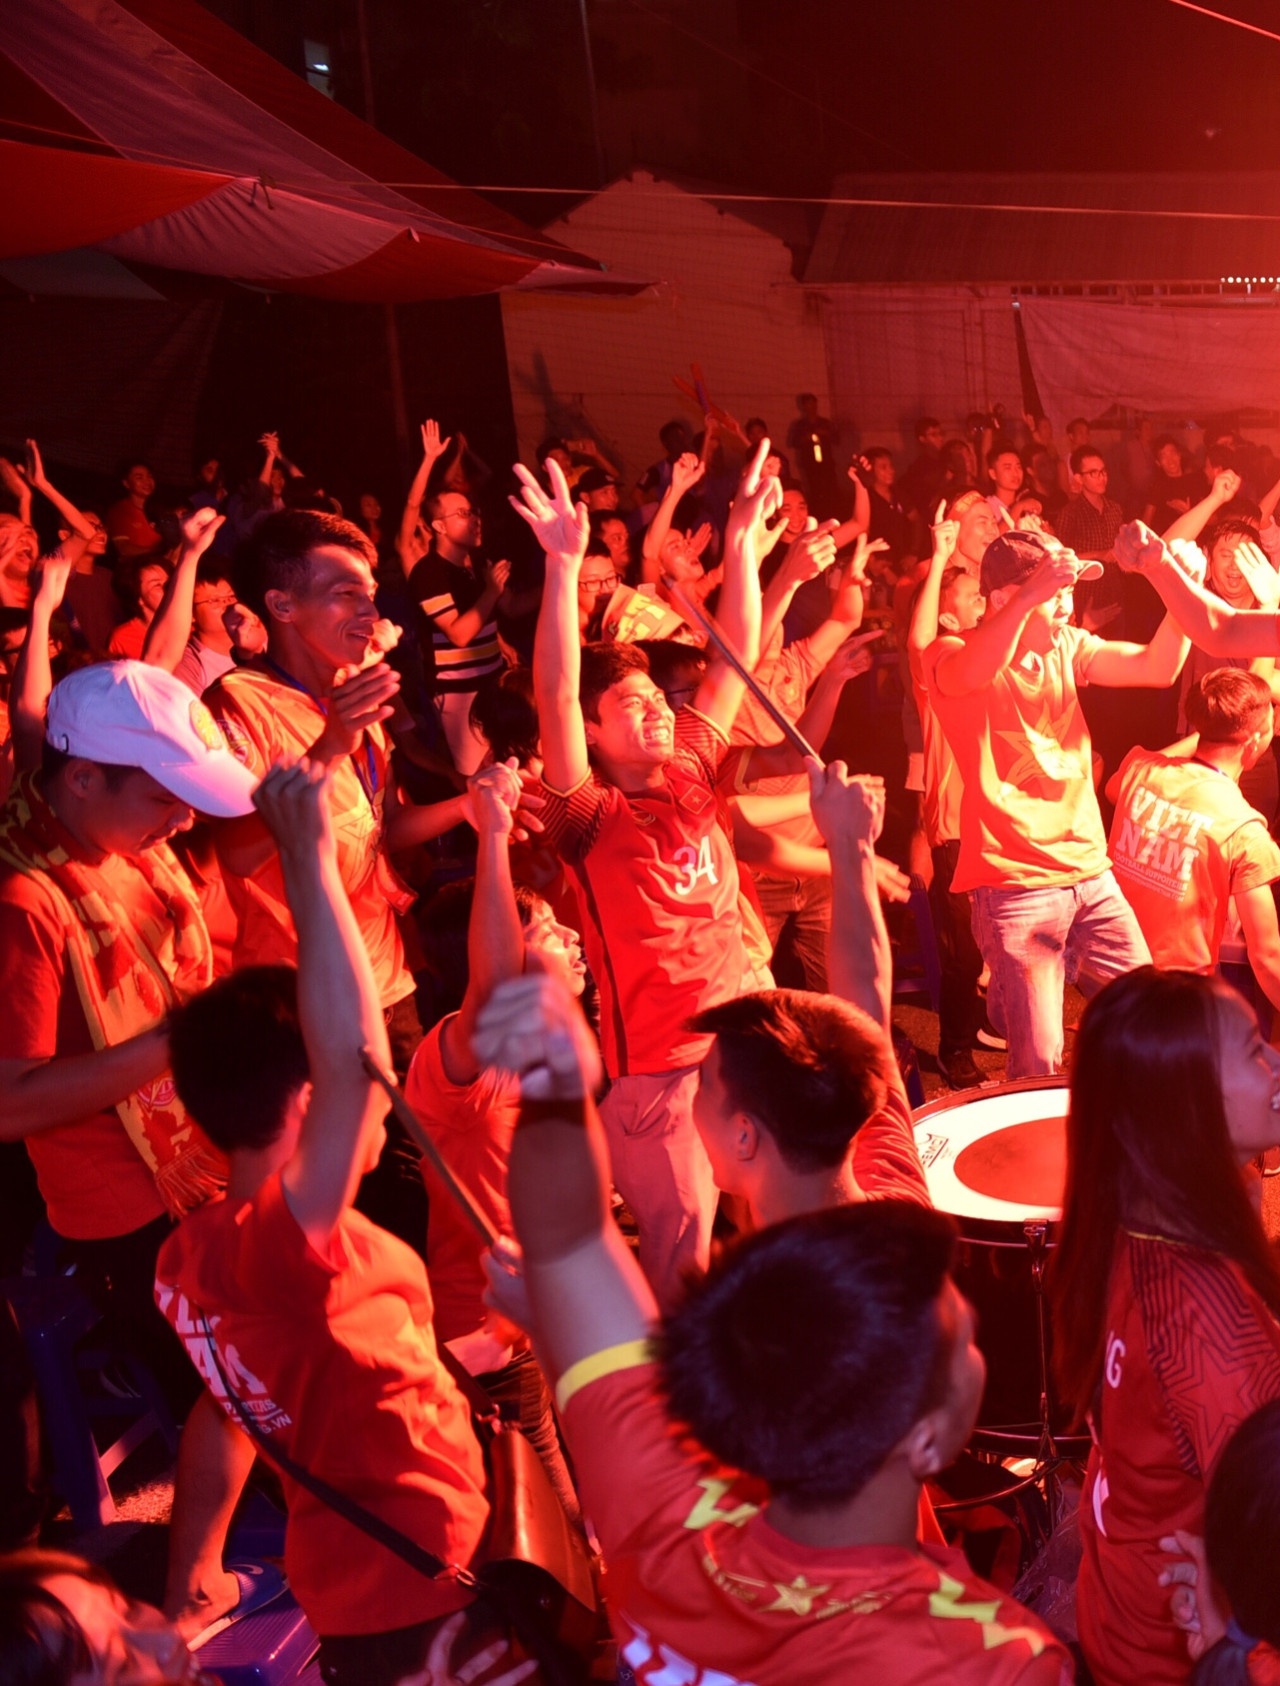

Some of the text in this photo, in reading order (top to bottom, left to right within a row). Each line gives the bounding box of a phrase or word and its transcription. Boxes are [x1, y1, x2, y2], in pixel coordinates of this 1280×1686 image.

[1130, 786, 1214, 845] VIET
[673, 835, 719, 896] 34
[1115, 817, 1199, 881] NAM
